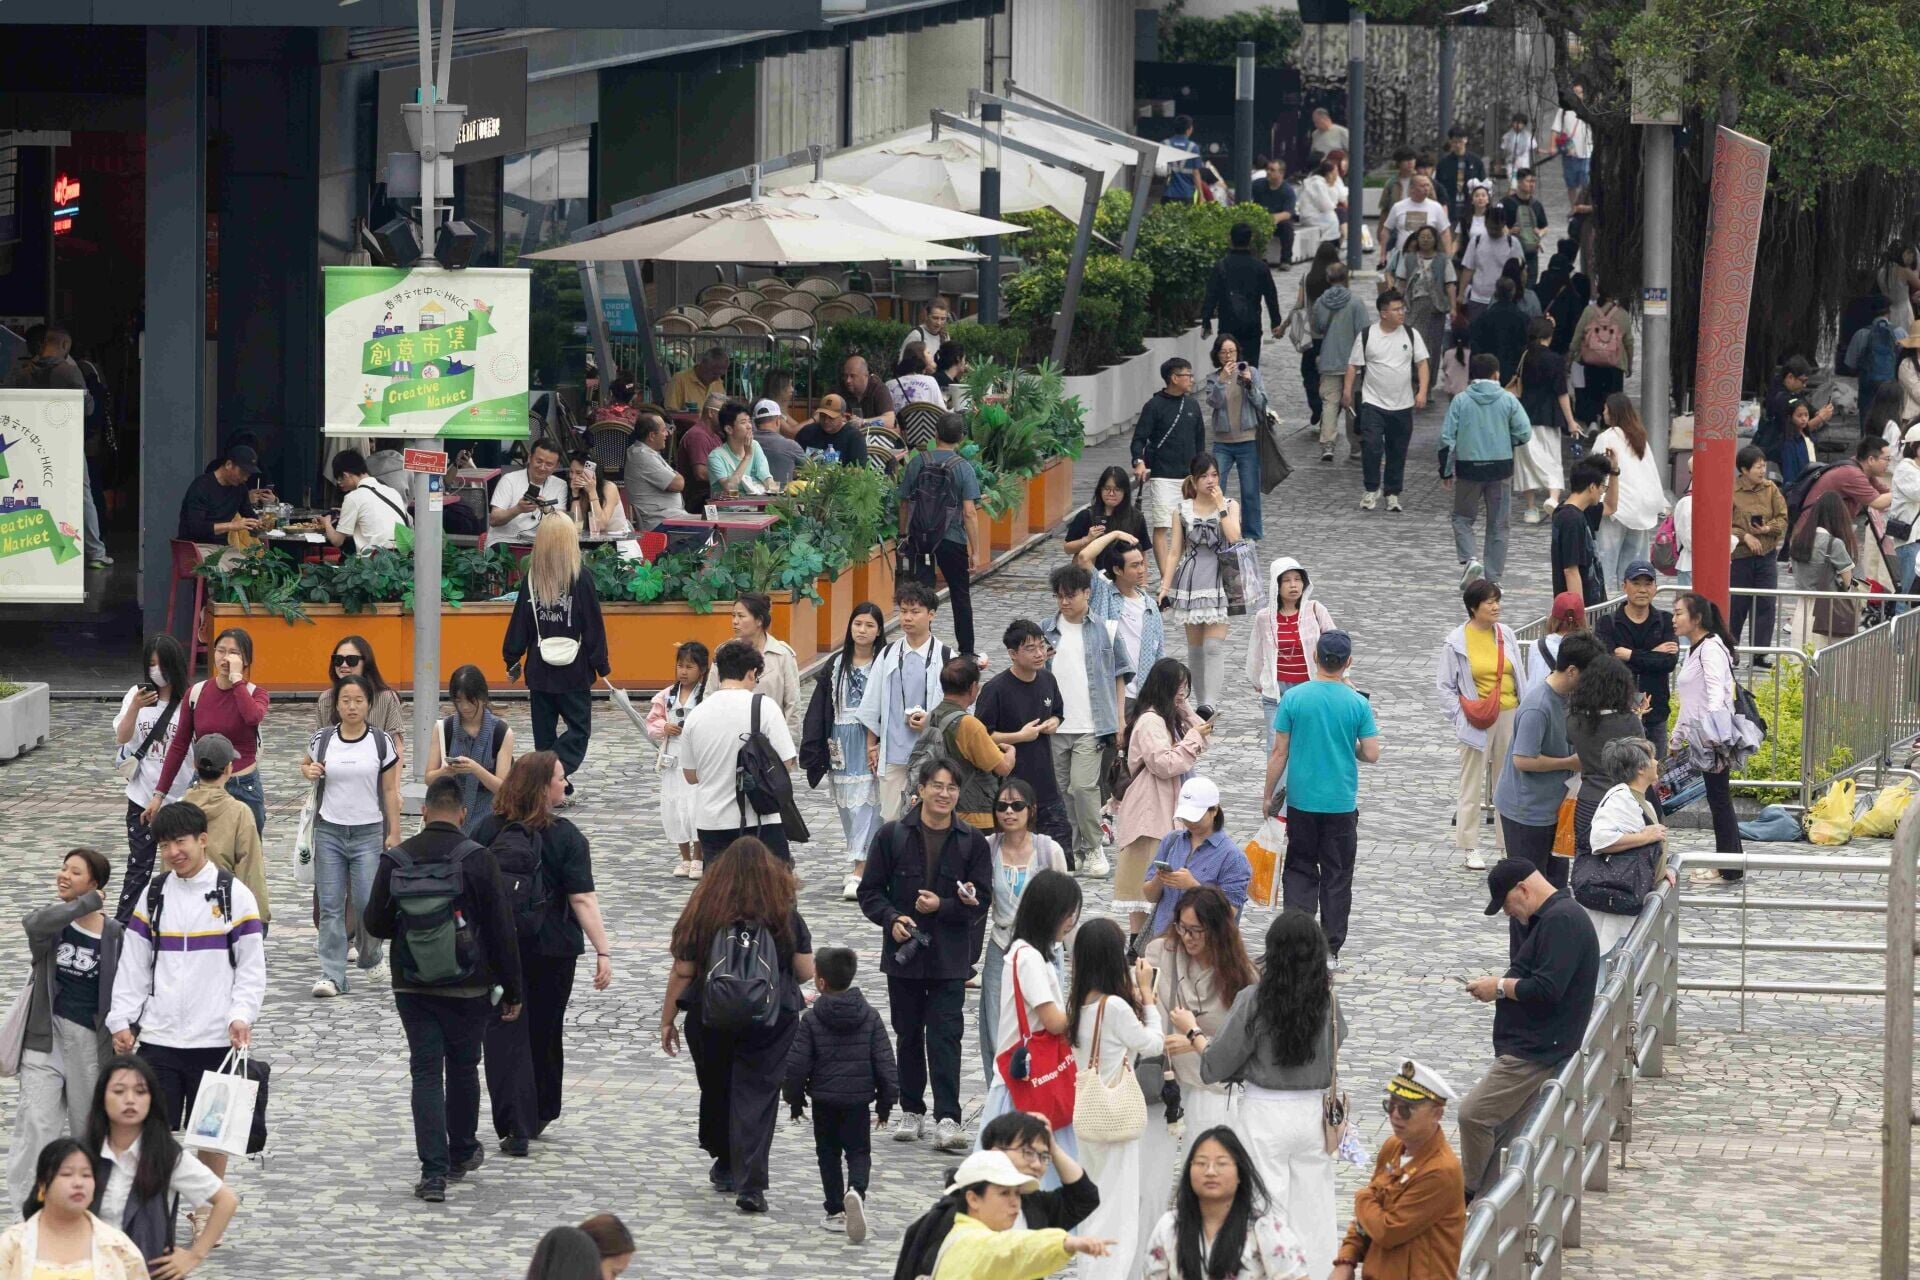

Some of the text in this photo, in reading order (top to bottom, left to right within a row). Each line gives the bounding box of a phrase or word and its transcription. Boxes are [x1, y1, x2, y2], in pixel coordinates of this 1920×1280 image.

[385, 287, 469, 311] 香港文化中心 HKCC
[370, 325, 465, 366] 創意市集
[389, 382, 440, 404] Creative
[427, 389, 467, 408] Market
[40, 456, 54, 488] HKCC
[3, 529, 50, 553] Market
[56, 942, 96, 972] 25
